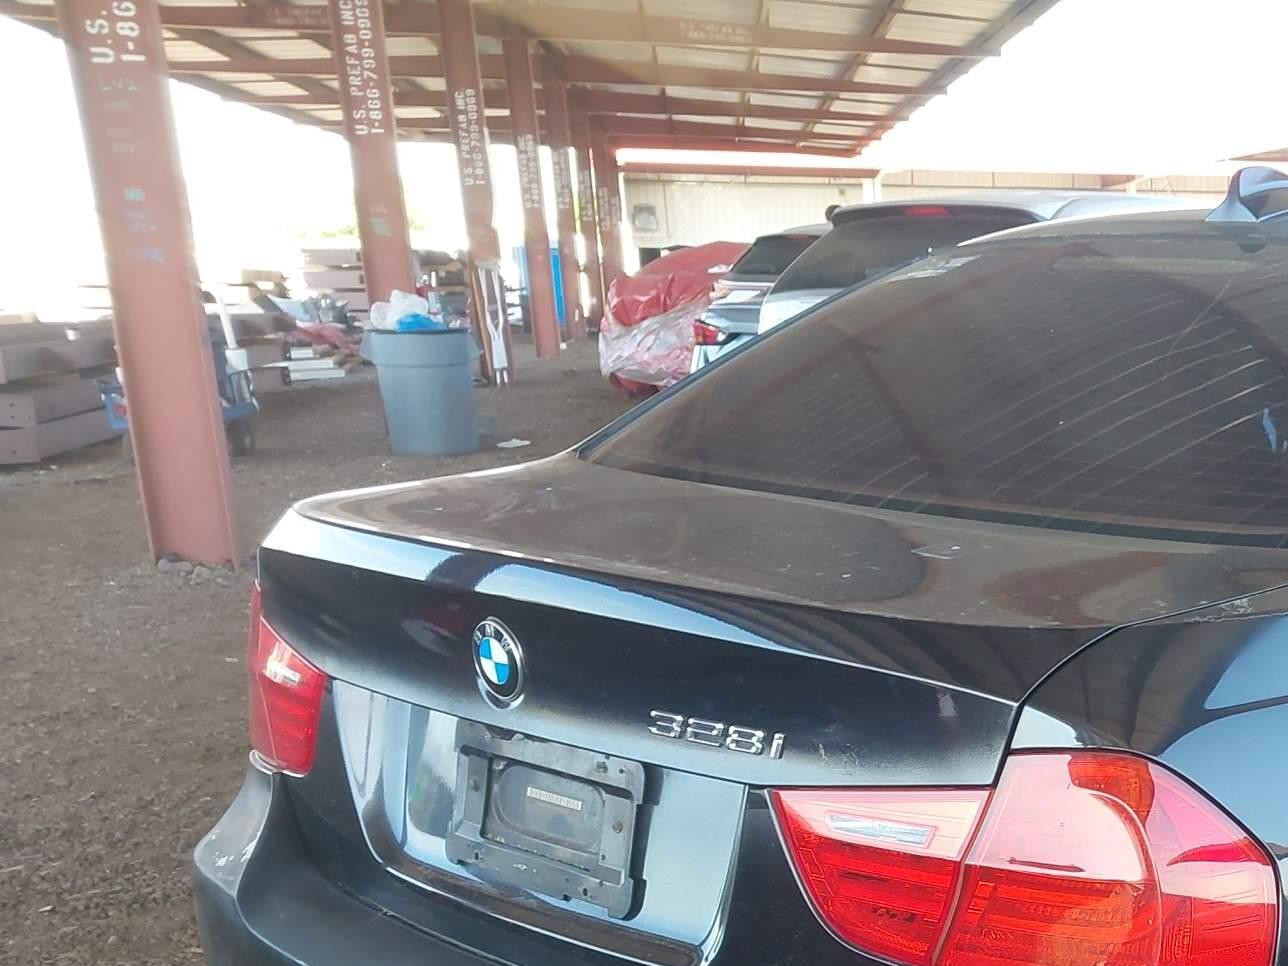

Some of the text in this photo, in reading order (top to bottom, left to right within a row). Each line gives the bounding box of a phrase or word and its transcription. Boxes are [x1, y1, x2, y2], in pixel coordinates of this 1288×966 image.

[85, 9, 115, 64] U.S.
[343, 33, 364, 97] PREFAB
[353, 104, 369, 136] U.S.
[648, 709, 786, 760] 328i
